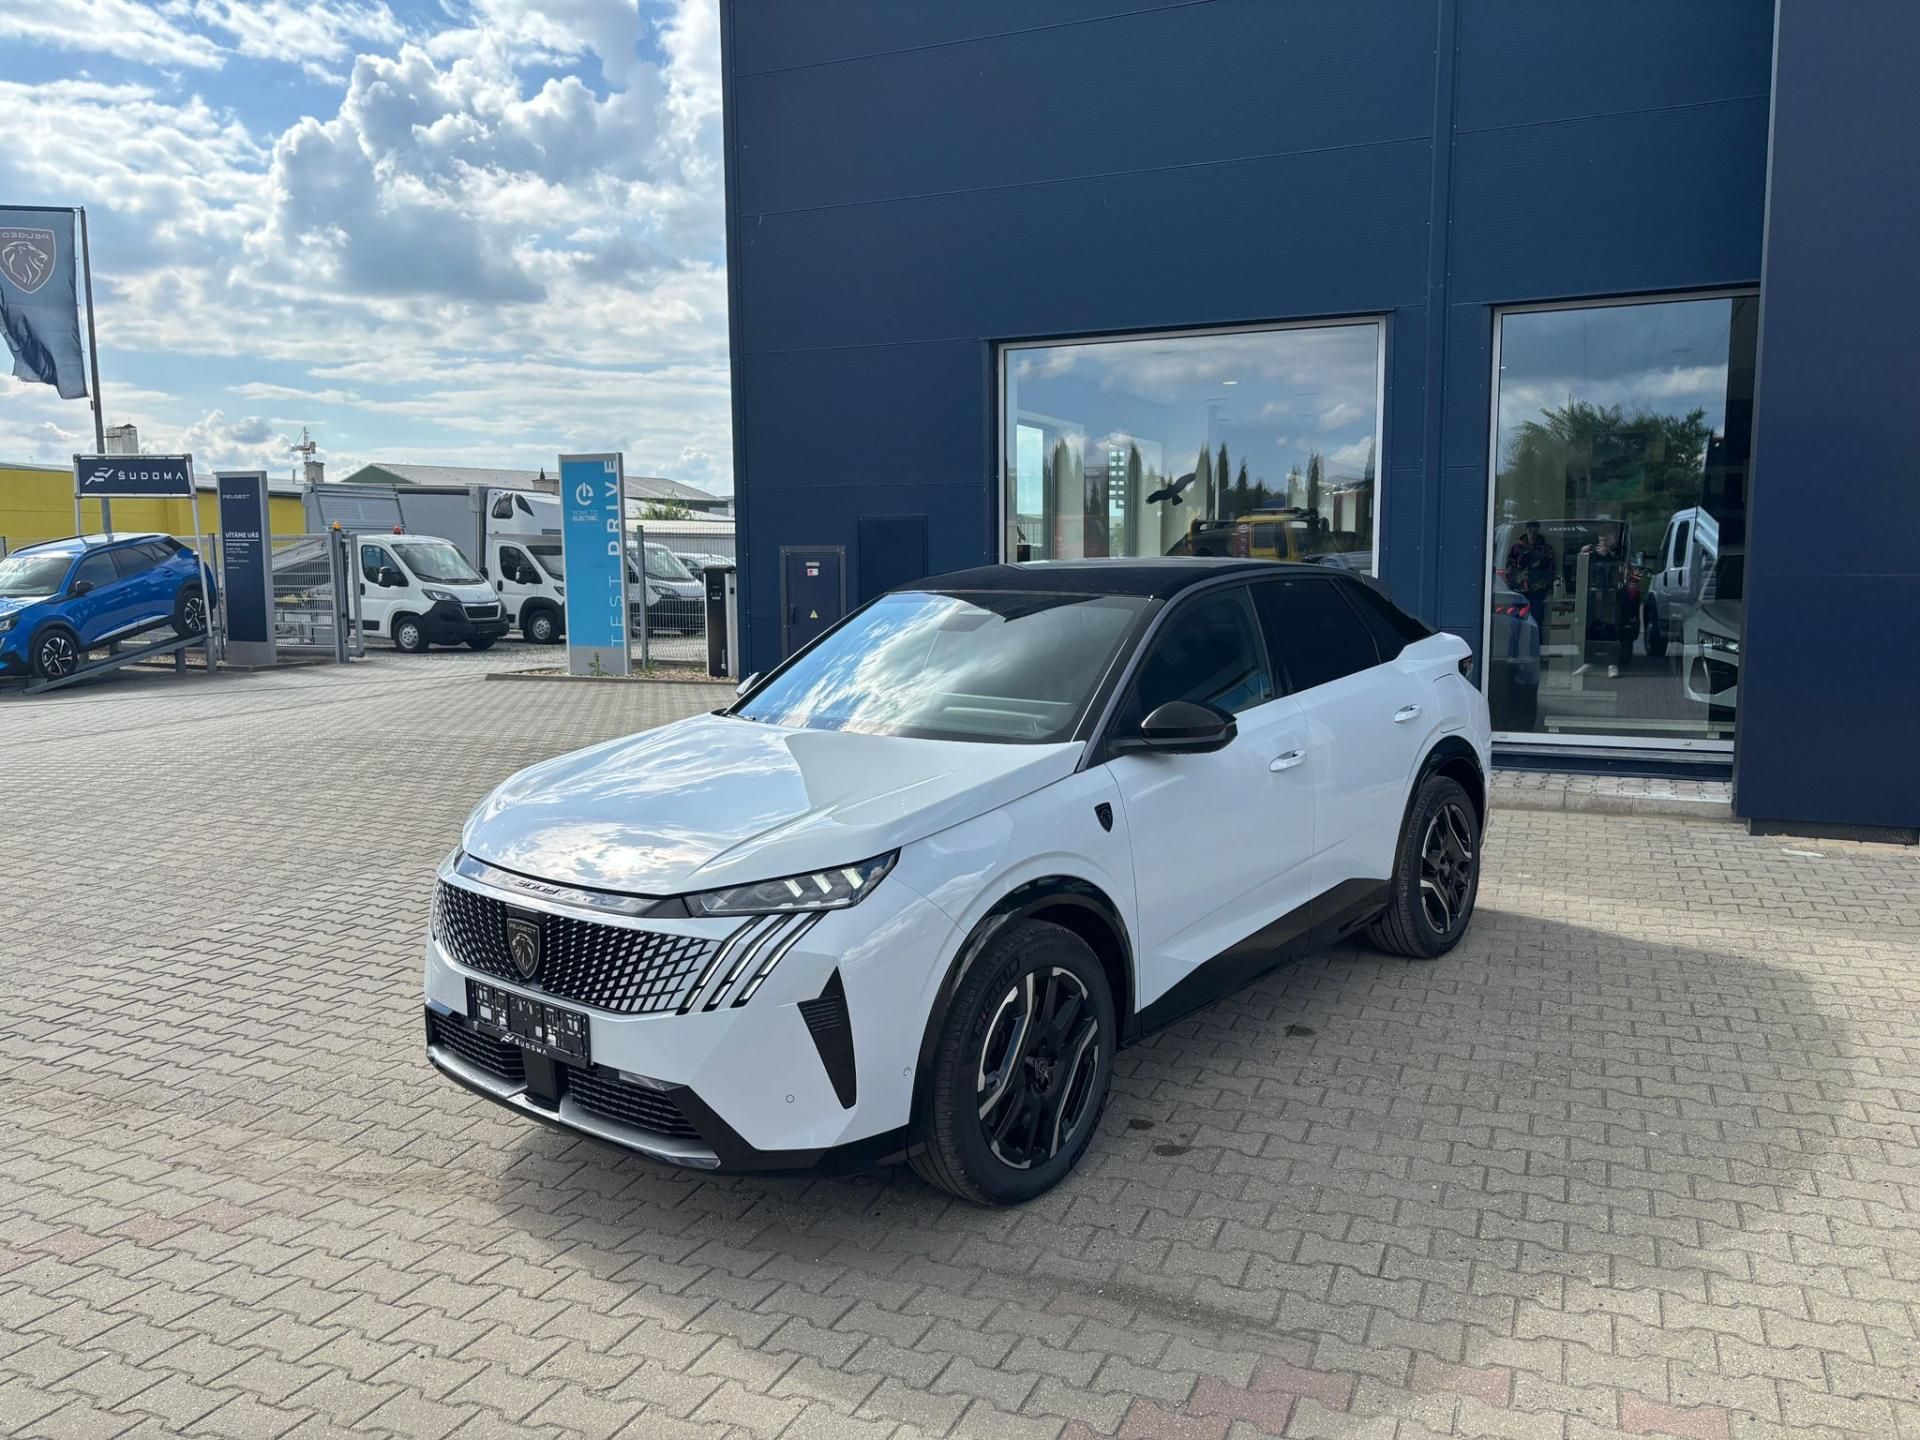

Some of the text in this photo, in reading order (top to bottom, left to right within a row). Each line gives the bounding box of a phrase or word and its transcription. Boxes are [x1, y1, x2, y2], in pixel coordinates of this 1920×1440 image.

[118, 471, 184, 480] ŠUDOMA
[604, 460, 624, 647] TEST DRIVE
